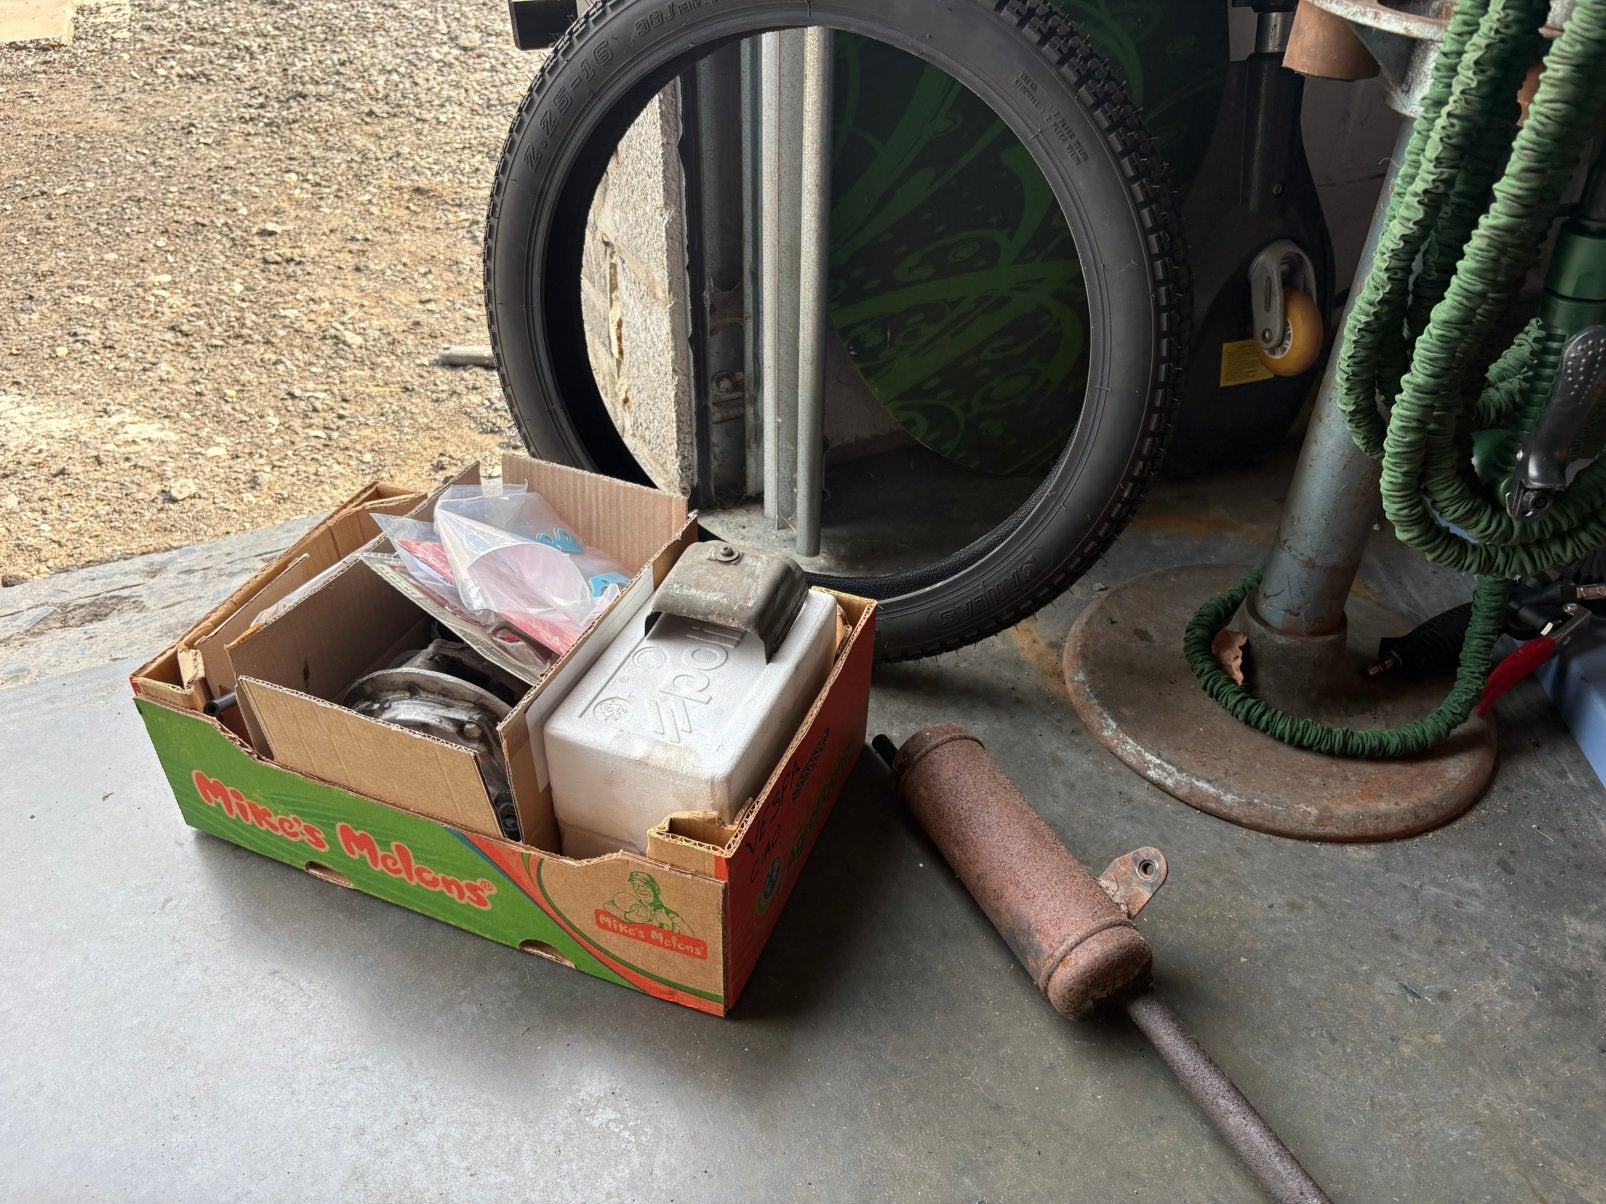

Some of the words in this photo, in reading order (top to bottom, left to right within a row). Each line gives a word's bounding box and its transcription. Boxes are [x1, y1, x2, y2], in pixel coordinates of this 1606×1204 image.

[634, 2, 677, 37] 38J
[523, 38, 614, 172] 2.25-16
[191, 769, 330, 853] Mike's
[745, 759, 801, 855] VESPA
[750, 824, 781, 884] CIAO
[599, 913, 645, 940] Mike's
